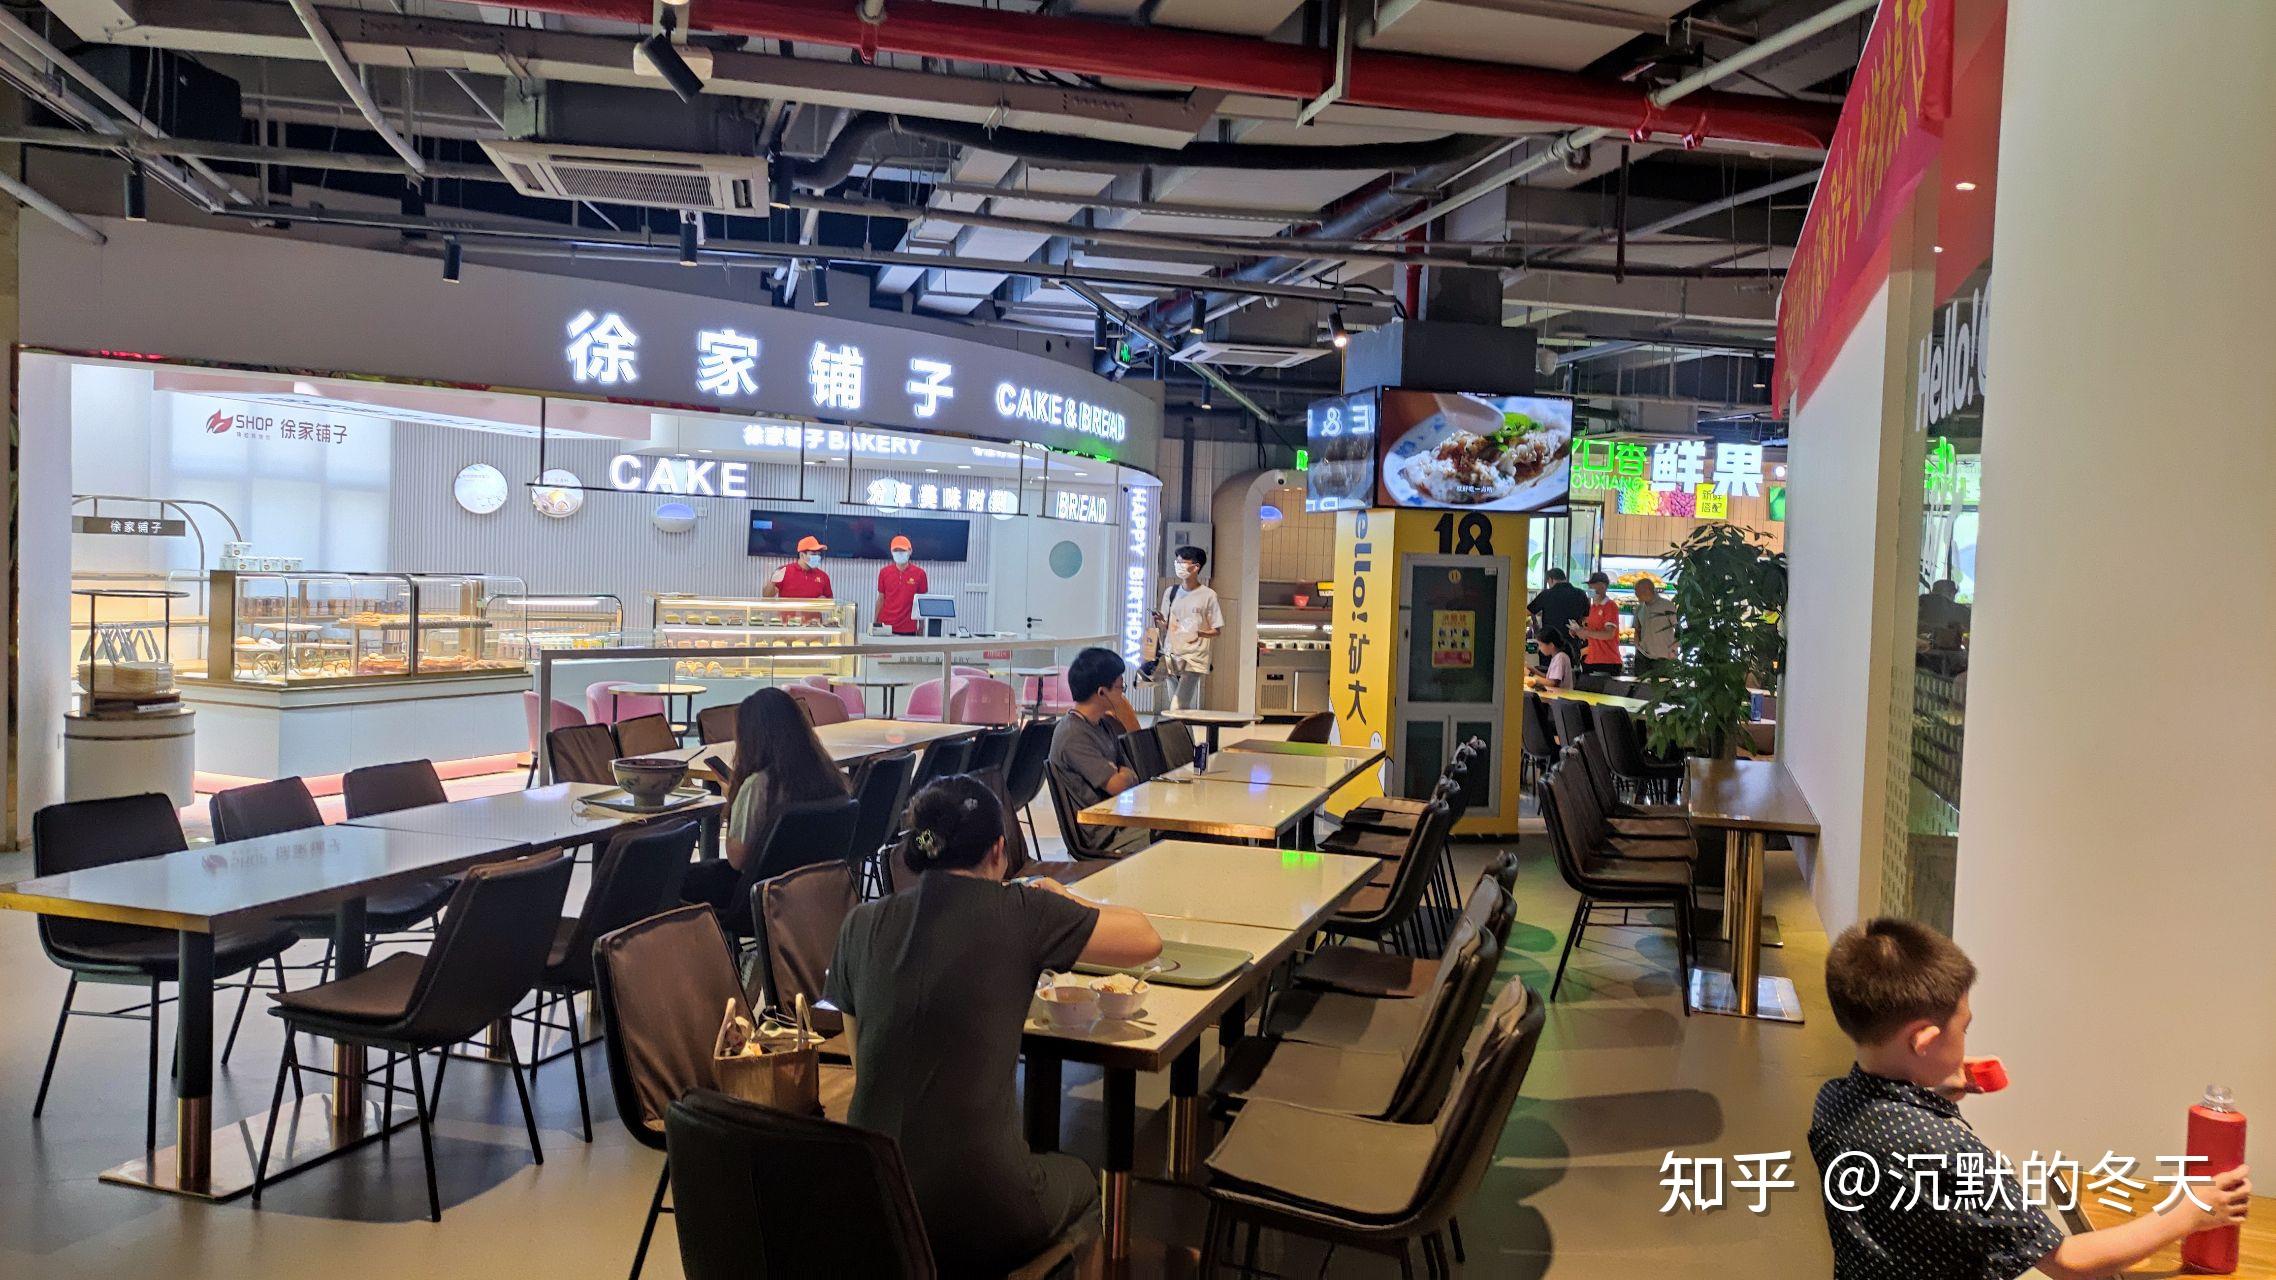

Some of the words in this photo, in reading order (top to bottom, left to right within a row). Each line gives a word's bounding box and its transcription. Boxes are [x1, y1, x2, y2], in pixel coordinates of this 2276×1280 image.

[566, 311, 954, 418] 徐家铺子
[236, 414, 273, 431] SHOP
[280, 419, 348, 444] 徐家铺子
[828, 430, 921, 454] BAKERY
[609, 454, 748, 498] CAKE
[1570, 473, 1643, 491] OUXIANG
[1651, 440, 1764, 498] 鲜果
[110, 520, 162, 534] 徐家铺子
[1056, 491, 1107, 523] BREAD
[1129, 488, 1147, 556] HAPPY
[1352, 510, 1372, 623] ello!
[1126, 567, 1145, 667] BIRTHDAY
[1346, 633, 1370, 726] 矿大
